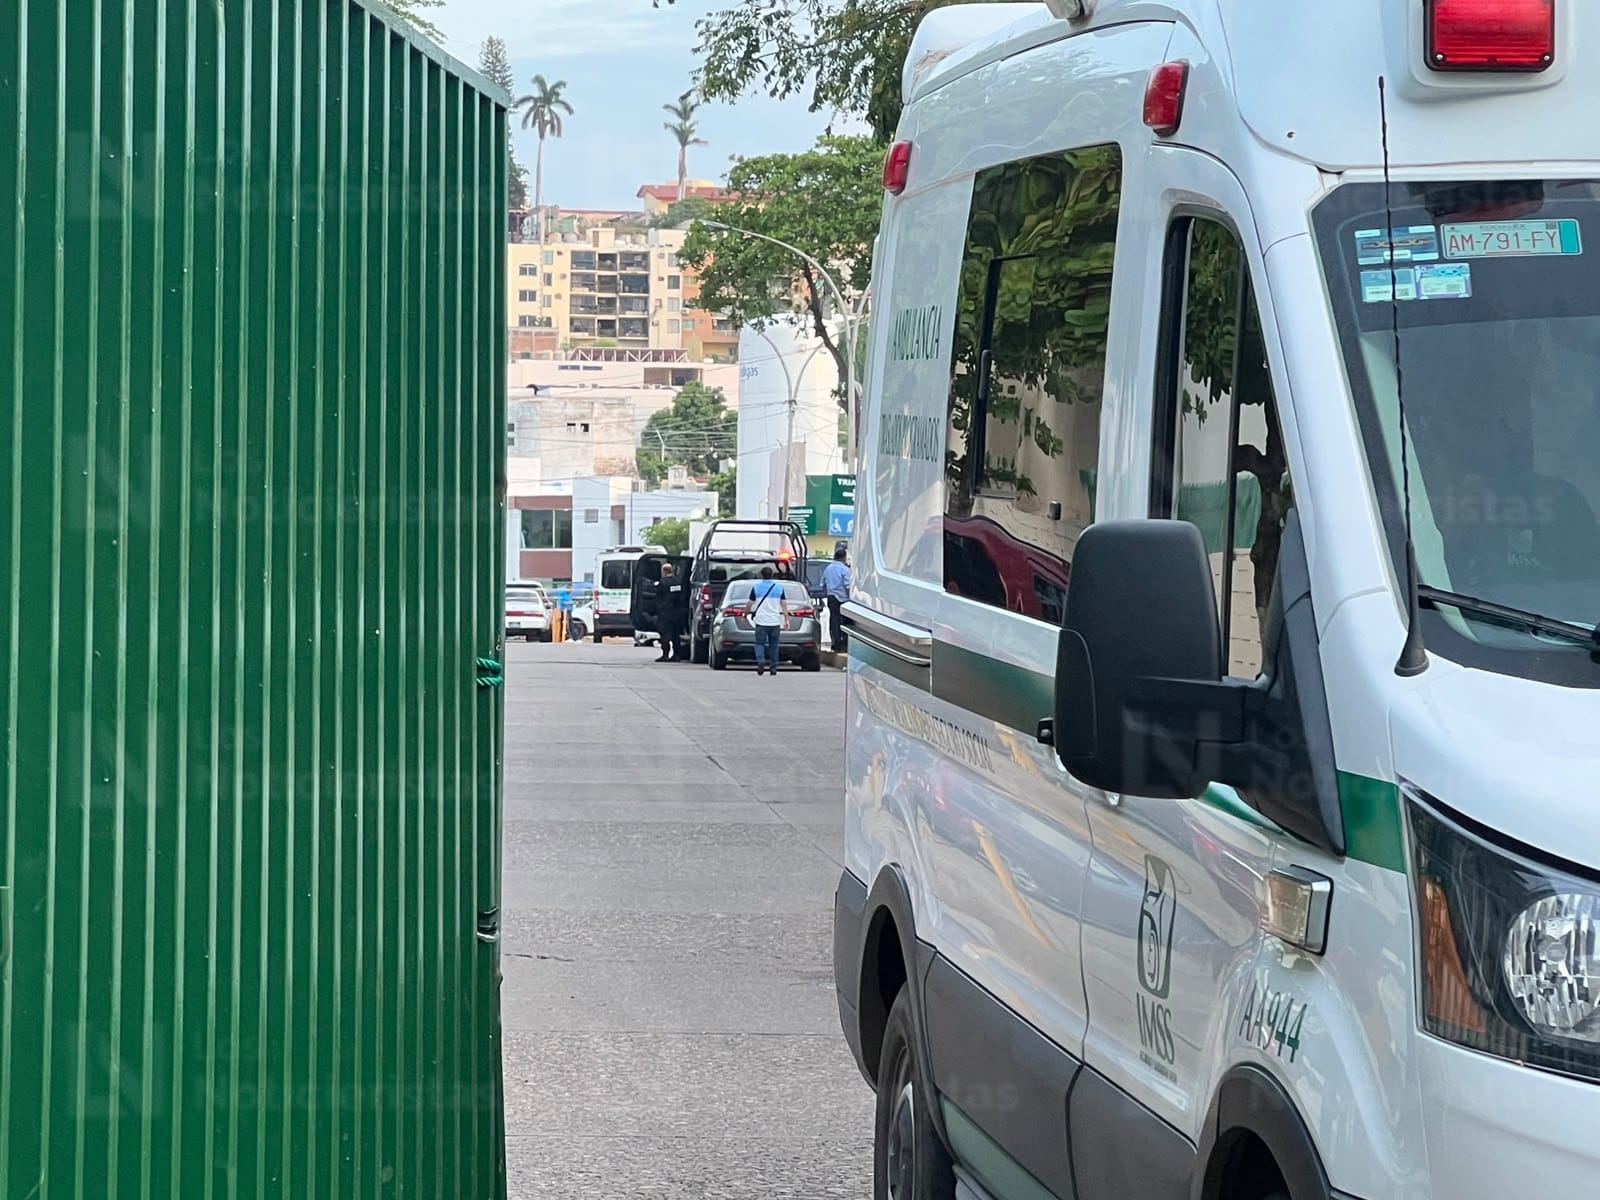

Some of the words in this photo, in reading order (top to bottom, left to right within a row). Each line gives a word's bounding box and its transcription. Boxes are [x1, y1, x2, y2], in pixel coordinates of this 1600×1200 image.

[1449, 230, 1558, 251] AM-791-FY
[1136, 992, 1174, 1065] IMSS
[1239, 980, 1307, 1063] AA944
